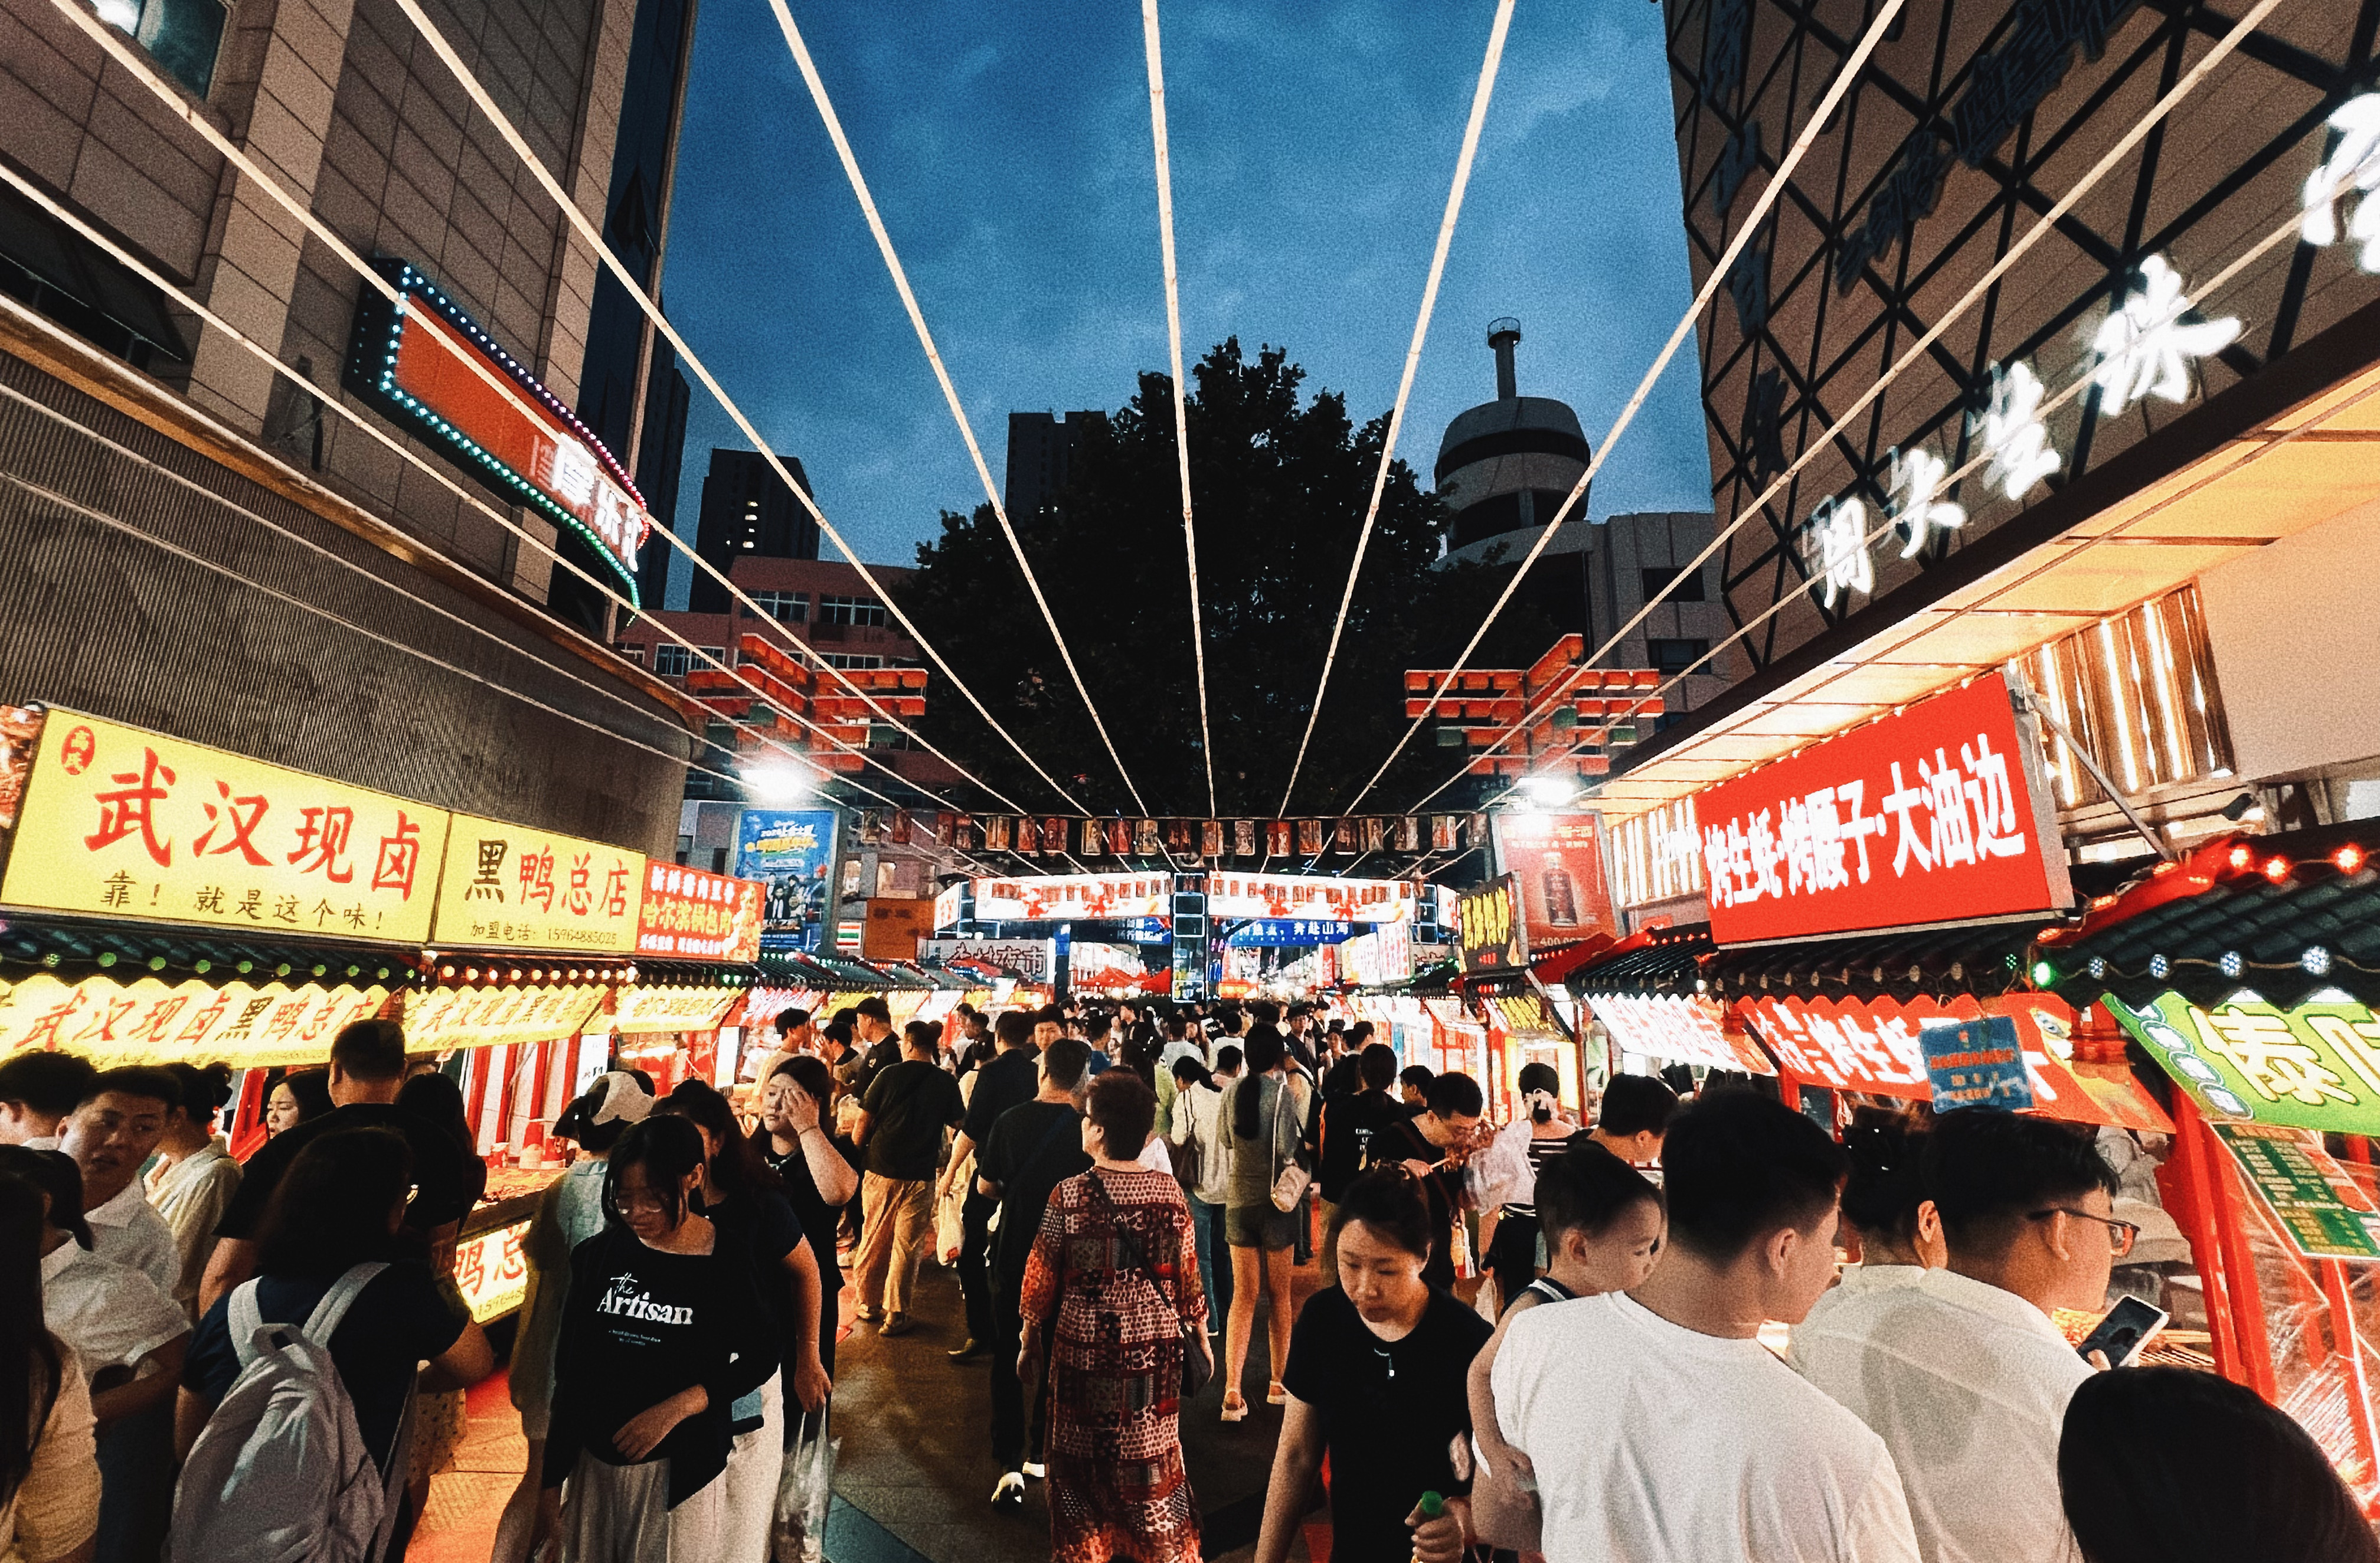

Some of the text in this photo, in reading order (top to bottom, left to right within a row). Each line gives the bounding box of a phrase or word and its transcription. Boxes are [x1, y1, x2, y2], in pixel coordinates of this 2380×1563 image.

[83, 747, 420, 902] 武汉现卤
[465, 839, 629, 919] 黑鸭总店
[642, 894, 733, 937] 哈尔滨锅包肉
[596, 1287, 693, 1325] Artisan
